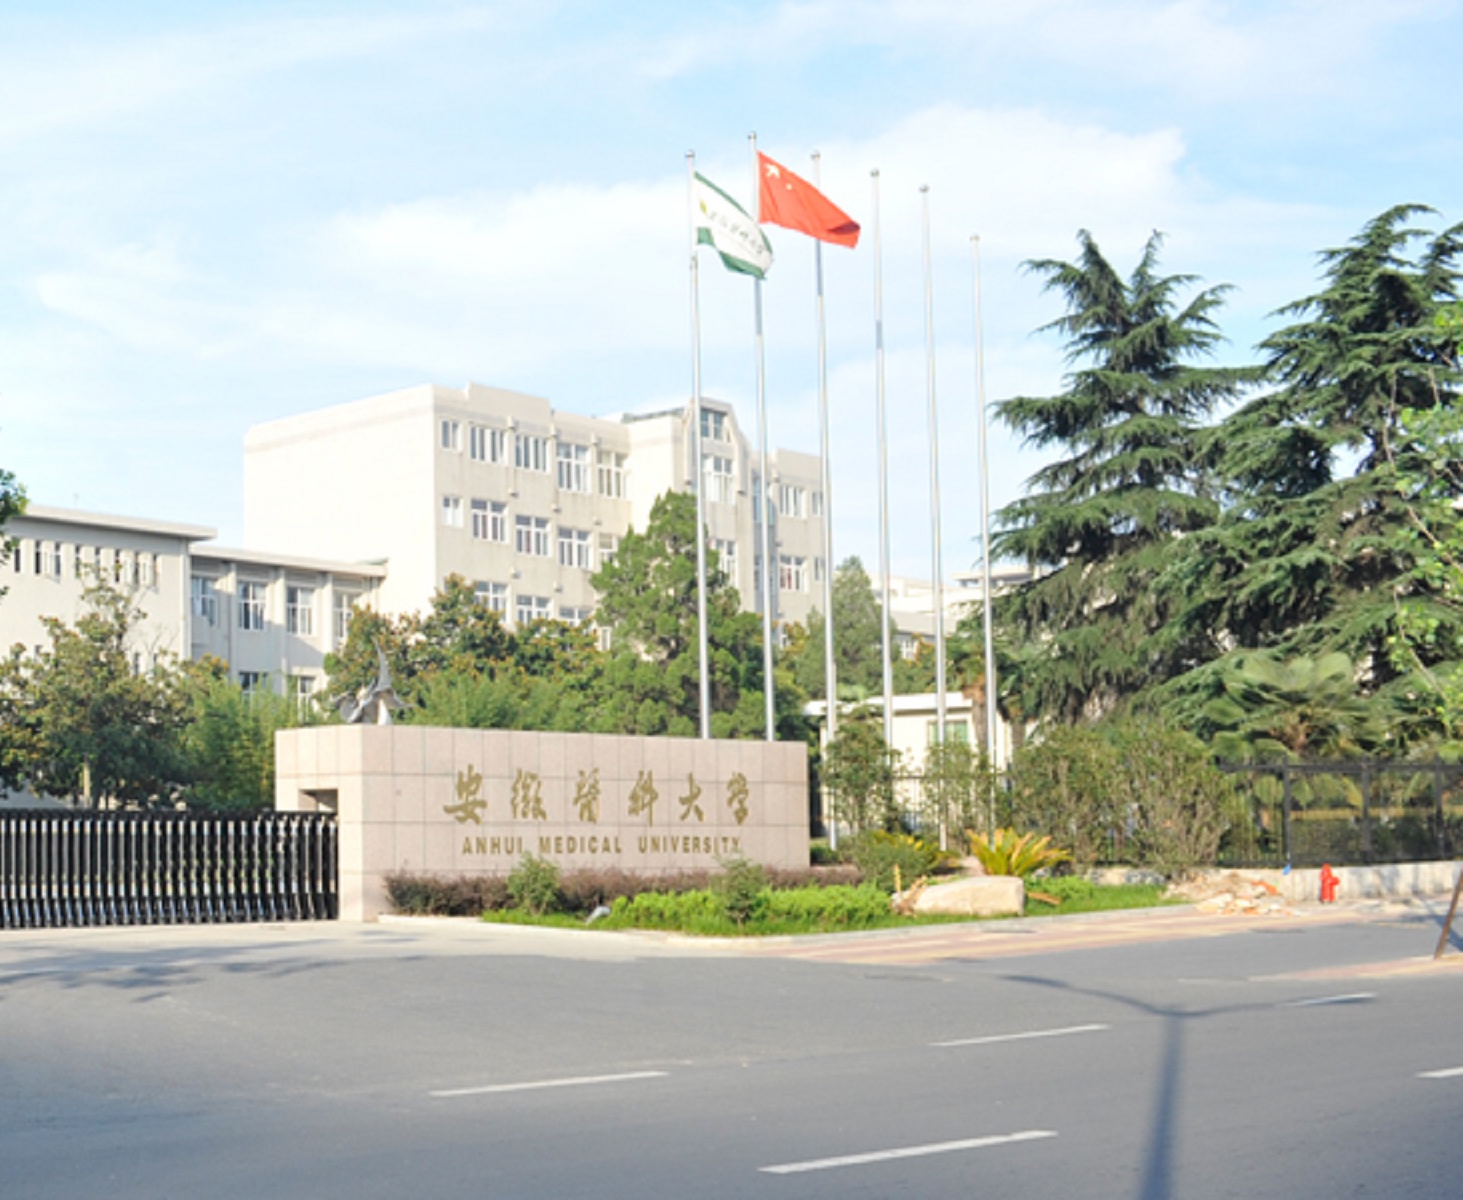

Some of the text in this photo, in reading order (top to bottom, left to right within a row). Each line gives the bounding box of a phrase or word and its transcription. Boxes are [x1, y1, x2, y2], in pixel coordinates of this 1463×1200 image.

[462, 836, 742, 855] ANHUI MEDICAL UNIVERSITY
